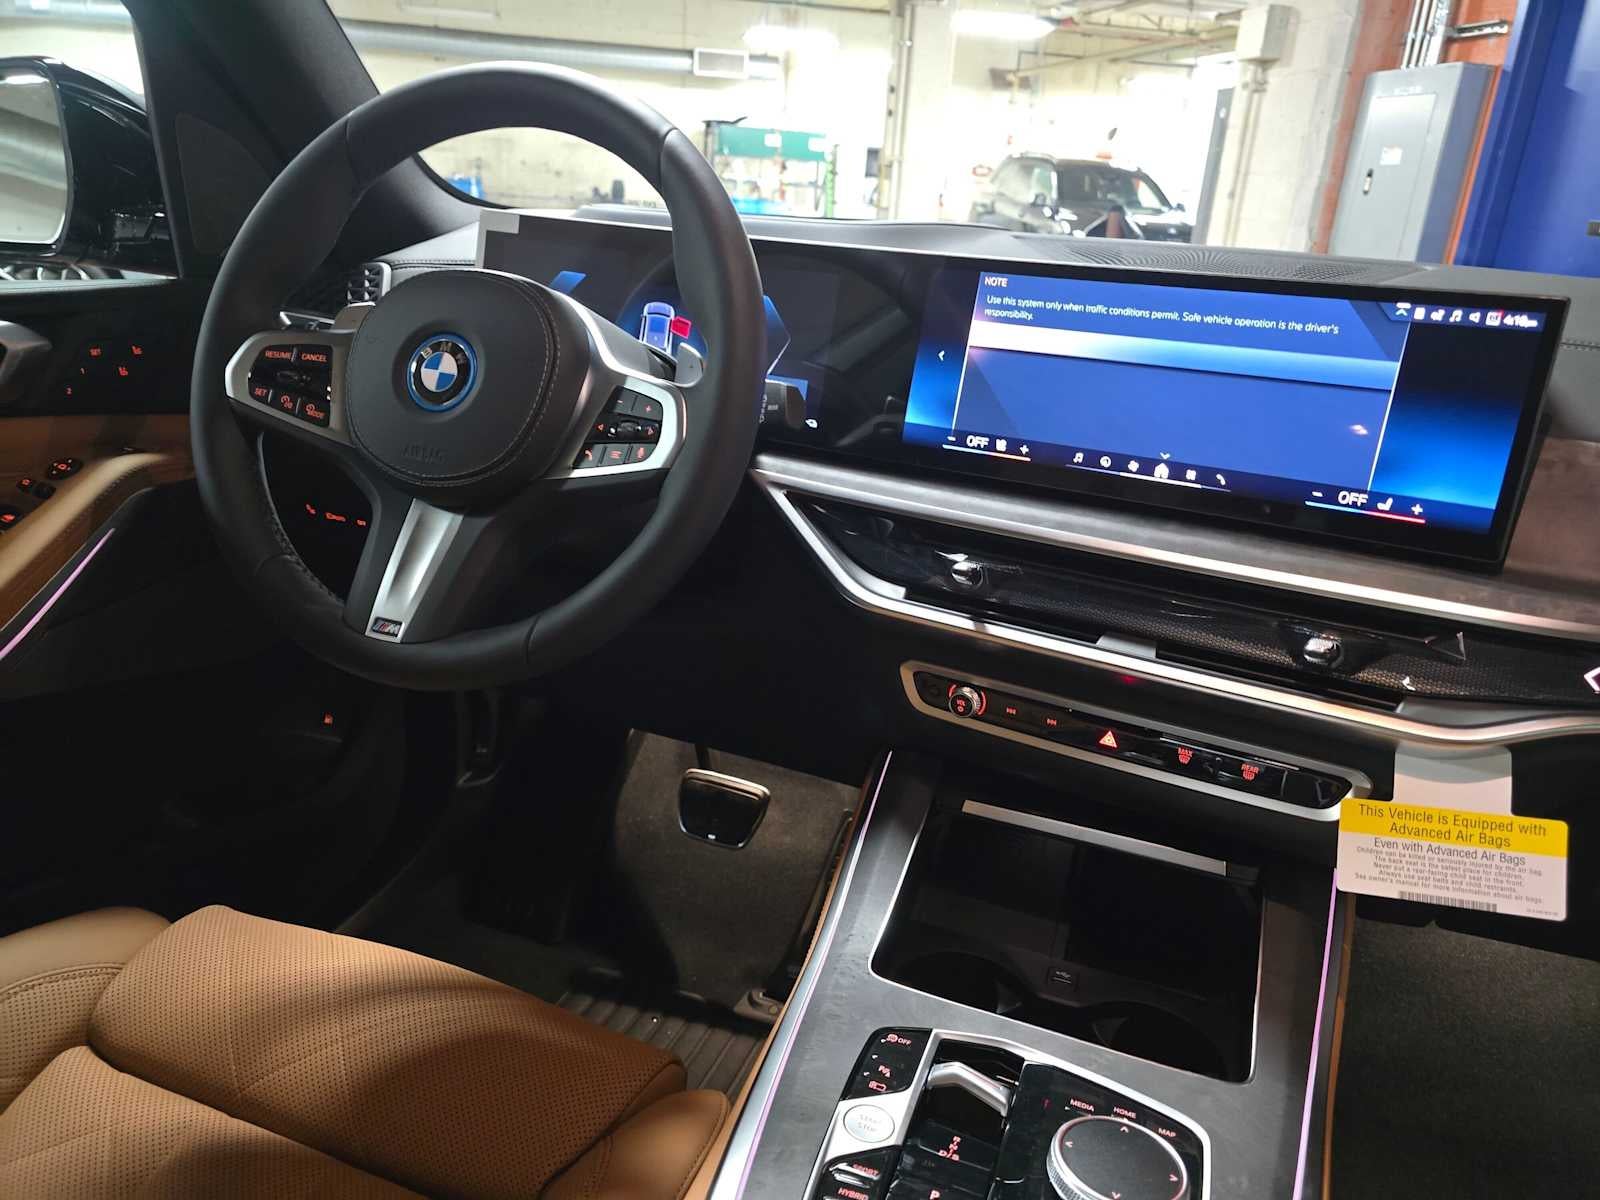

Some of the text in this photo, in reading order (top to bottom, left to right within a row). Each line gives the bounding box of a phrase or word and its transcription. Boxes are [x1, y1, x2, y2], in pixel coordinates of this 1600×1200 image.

[984, 276, 1008, 288] NOTE
[984, 308, 1034, 320] responsibility.
[986, 296, 1340, 334] Use this system only when traffic conditions permit. Safe vehicle operation is the driver's
[266, 350, 292, 360] RESUME
[302, 353, 327, 362] CANCEL
[255, 388, 268, 396] SET
[966, 434, 990, 448] OFF
[1338, 490, 1368, 506] OFF
[1360, 804, 1546, 836] This Vehicle is Equipped with
[1390, 822, 1511, 848] Advanced Air Bags
[1374, 838, 1526, 866] Even with Advanced Air Bags
[1070, 1098, 1094, 1112] MEDIA
[1113, 1106, 1136, 1118] HOME
[1158, 1127, 1176, 1138] MAP
[838, 1187, 870, 1200] HYBRID
